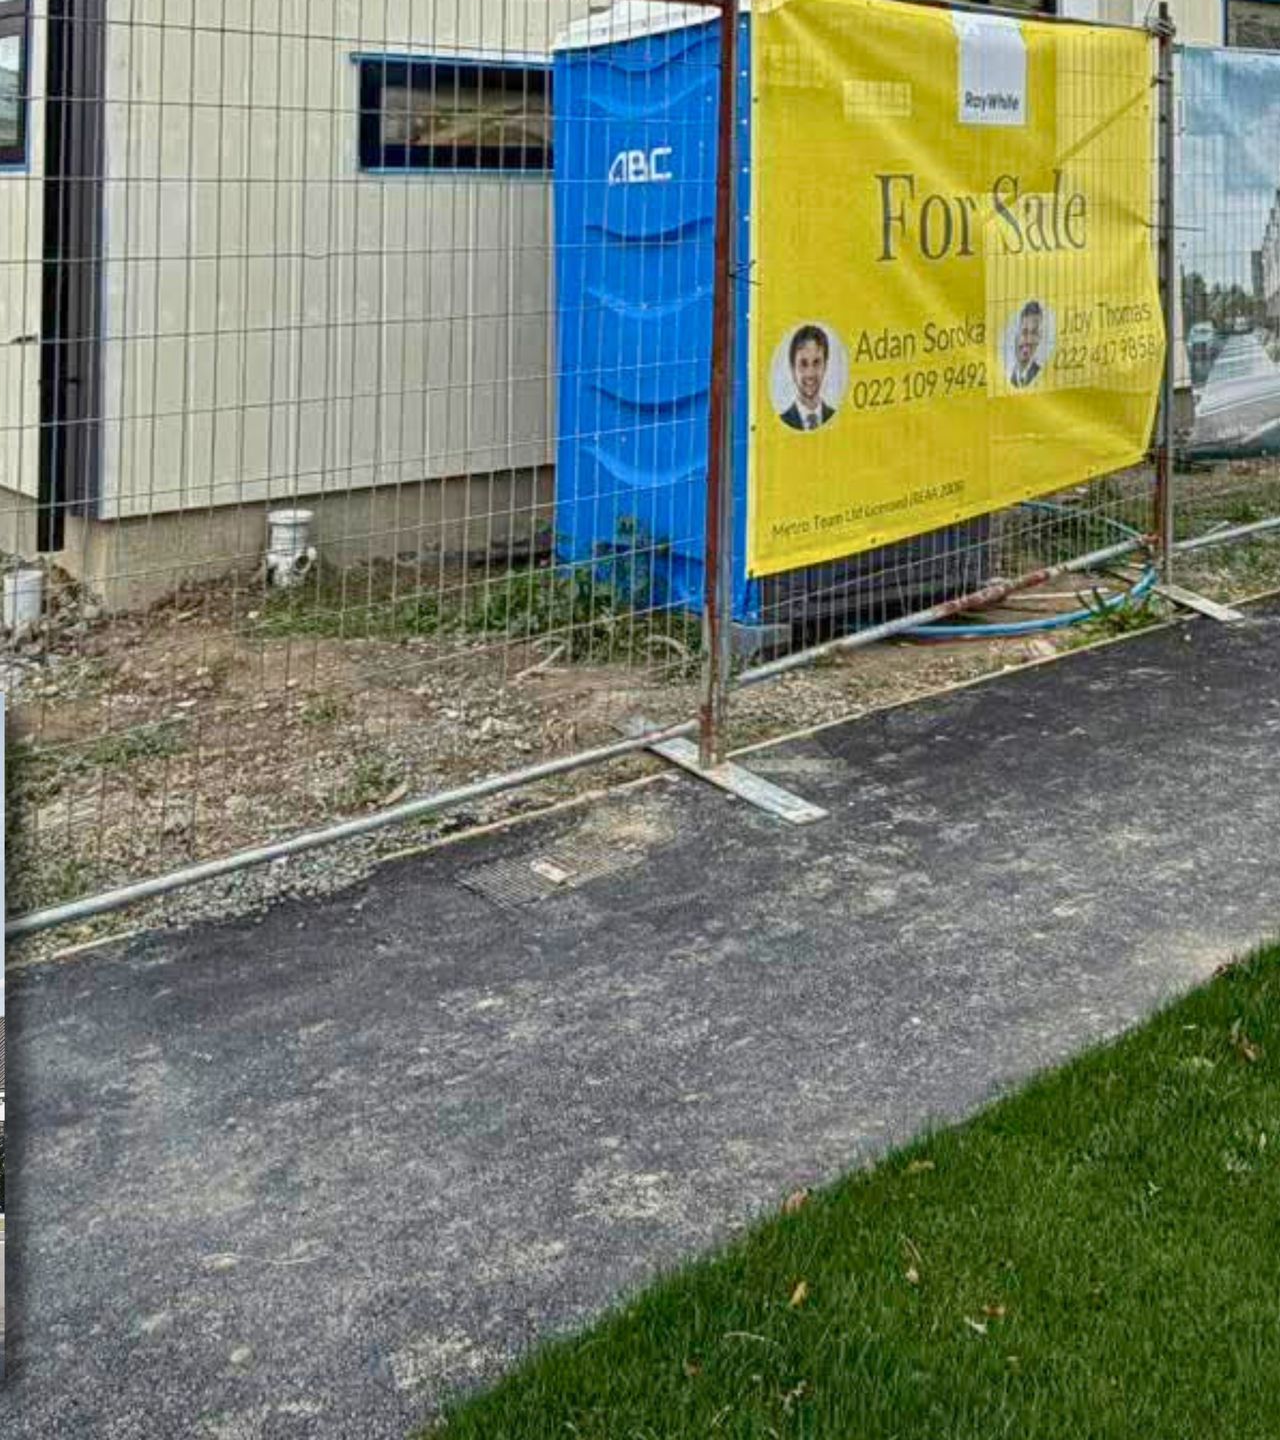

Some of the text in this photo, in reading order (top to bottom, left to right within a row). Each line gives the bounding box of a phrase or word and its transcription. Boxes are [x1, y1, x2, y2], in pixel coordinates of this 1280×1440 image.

[608, 147, 672, 186] ABC
[874, 168, 1087, 262] For Sale
[854, 315, 985, 363] Adan Soroka
[853, 363, 987, 409] 022 109 9492
